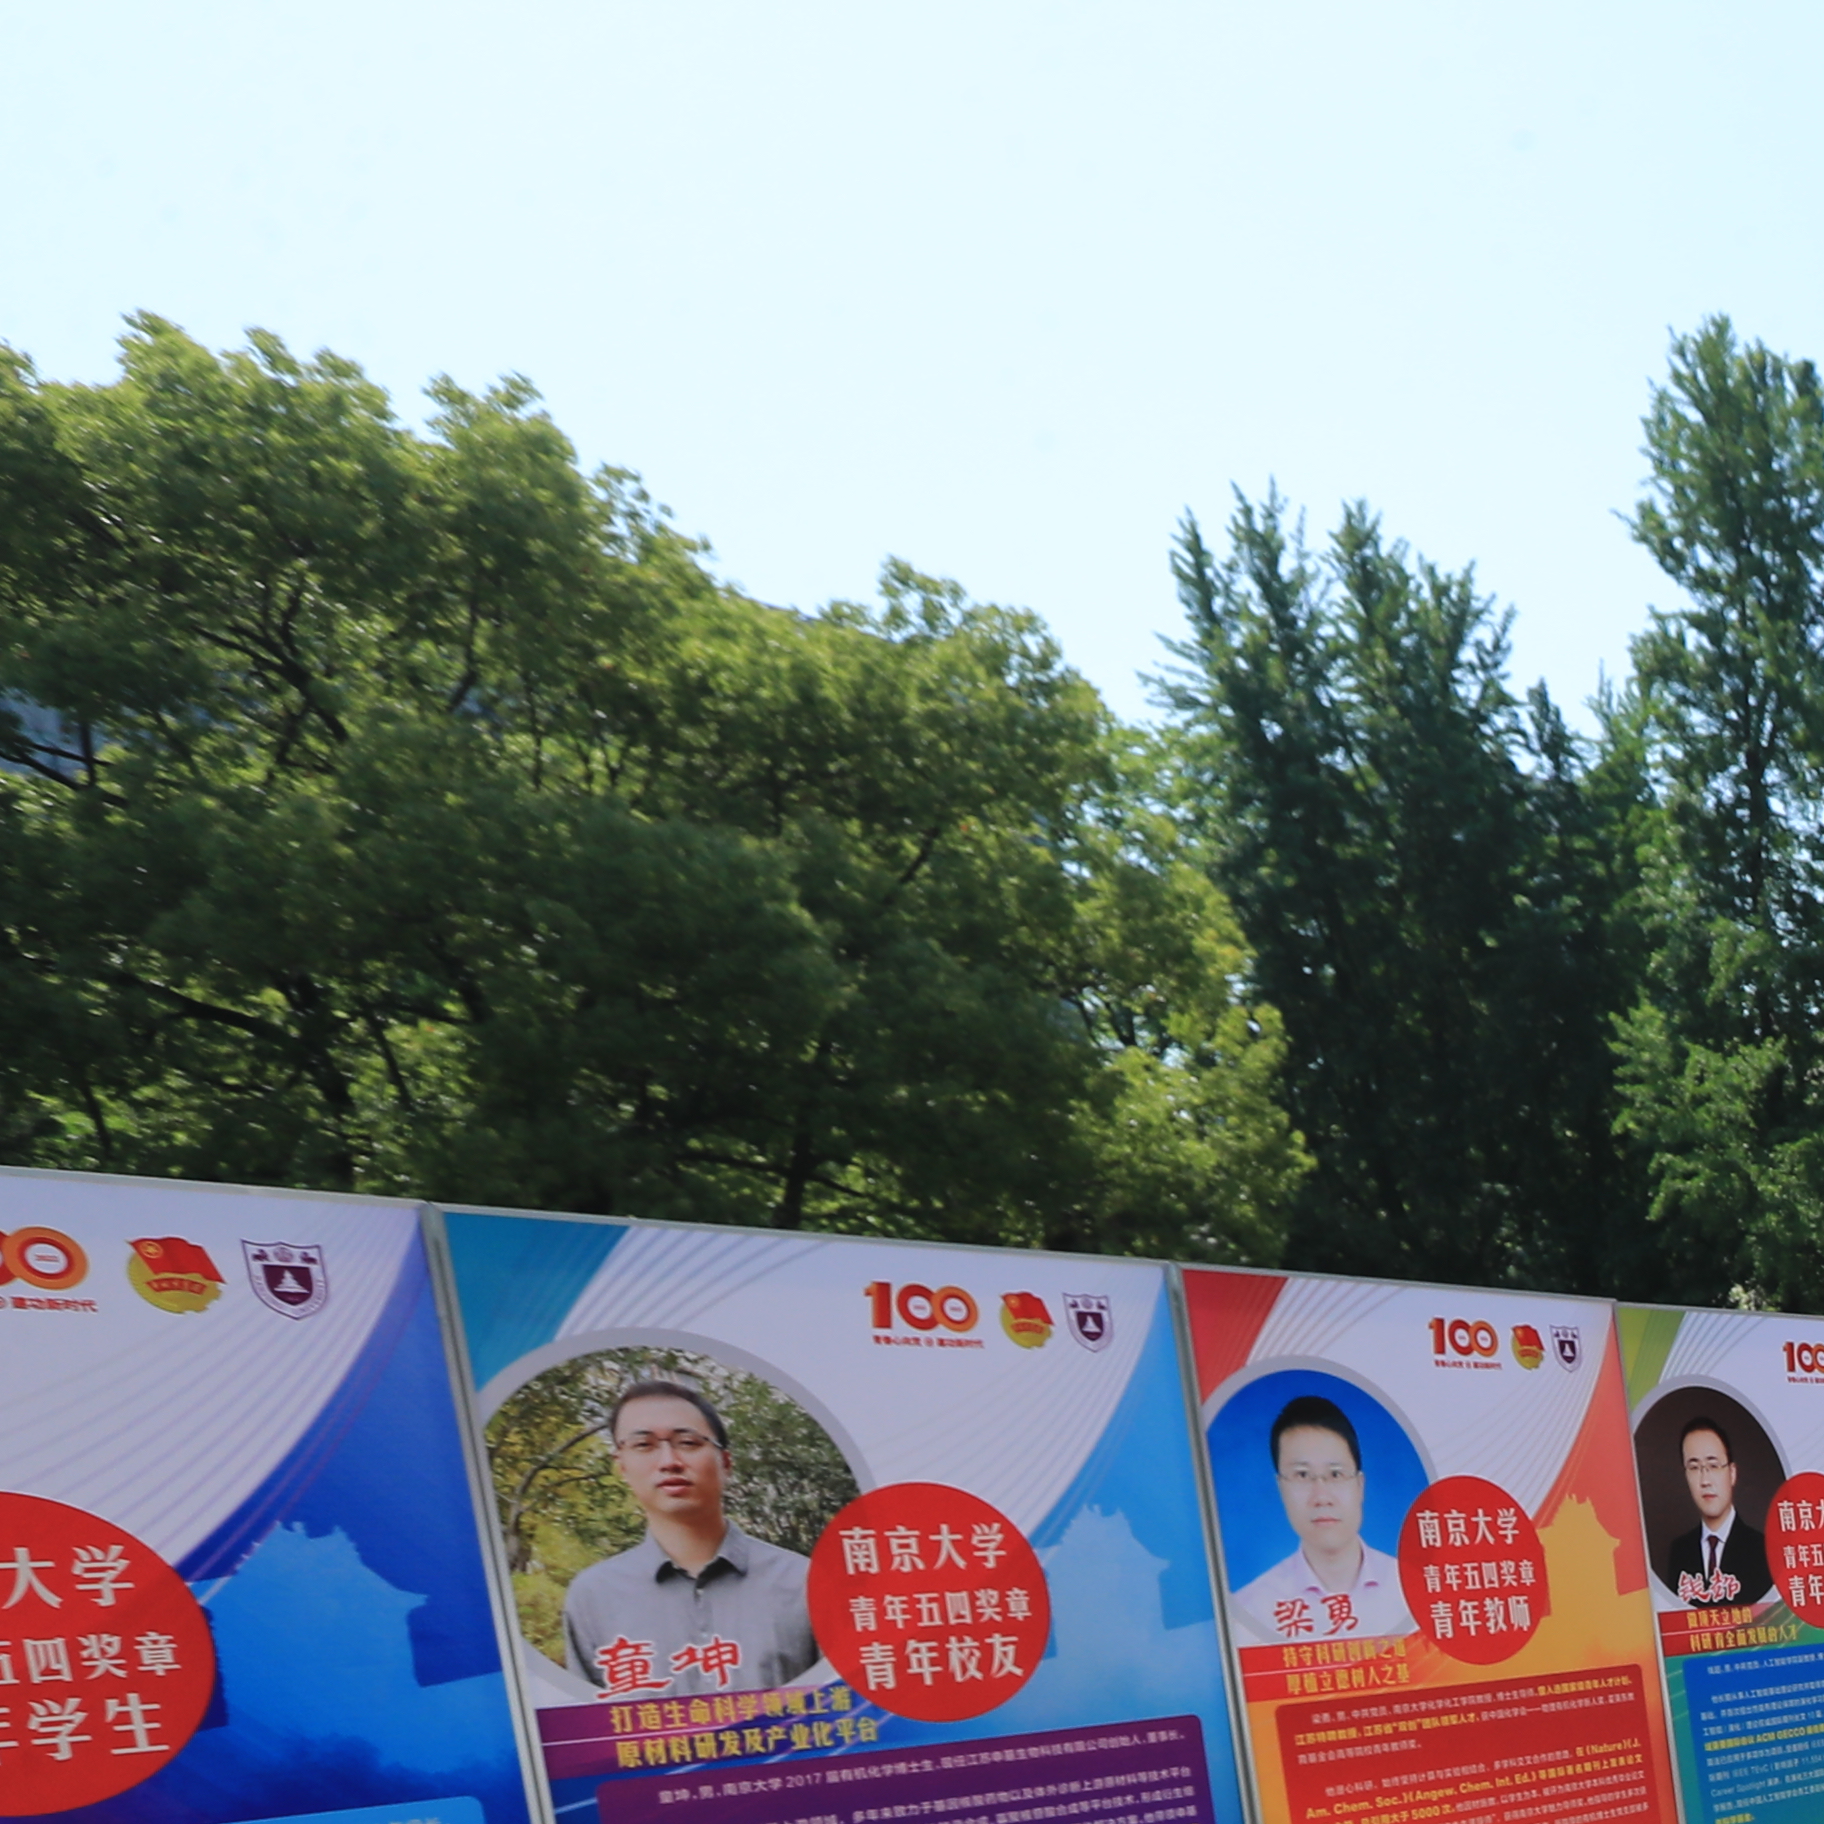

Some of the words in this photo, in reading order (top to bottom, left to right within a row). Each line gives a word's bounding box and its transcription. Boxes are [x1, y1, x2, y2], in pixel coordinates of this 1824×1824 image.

[1428, 1317, 1498, 1357] 100
[839, 1522, 1009, 1575] 南京大学
[1415, 1506, 1521, 1548] 南京大学
[1421, 1558, 1536, 1594] 青年五四奖章
[847, 1587, 1033, 1632] 青年五四奖章
[1428, 1594, 1532, 1640] 青年教师
[857, 1632, 1024, 1691] 青年校友
[608, 1686, 854, 1734] 打造生命科学领域上游
[613, 1715, 879, 1770] 原材料研发及产业化平台
